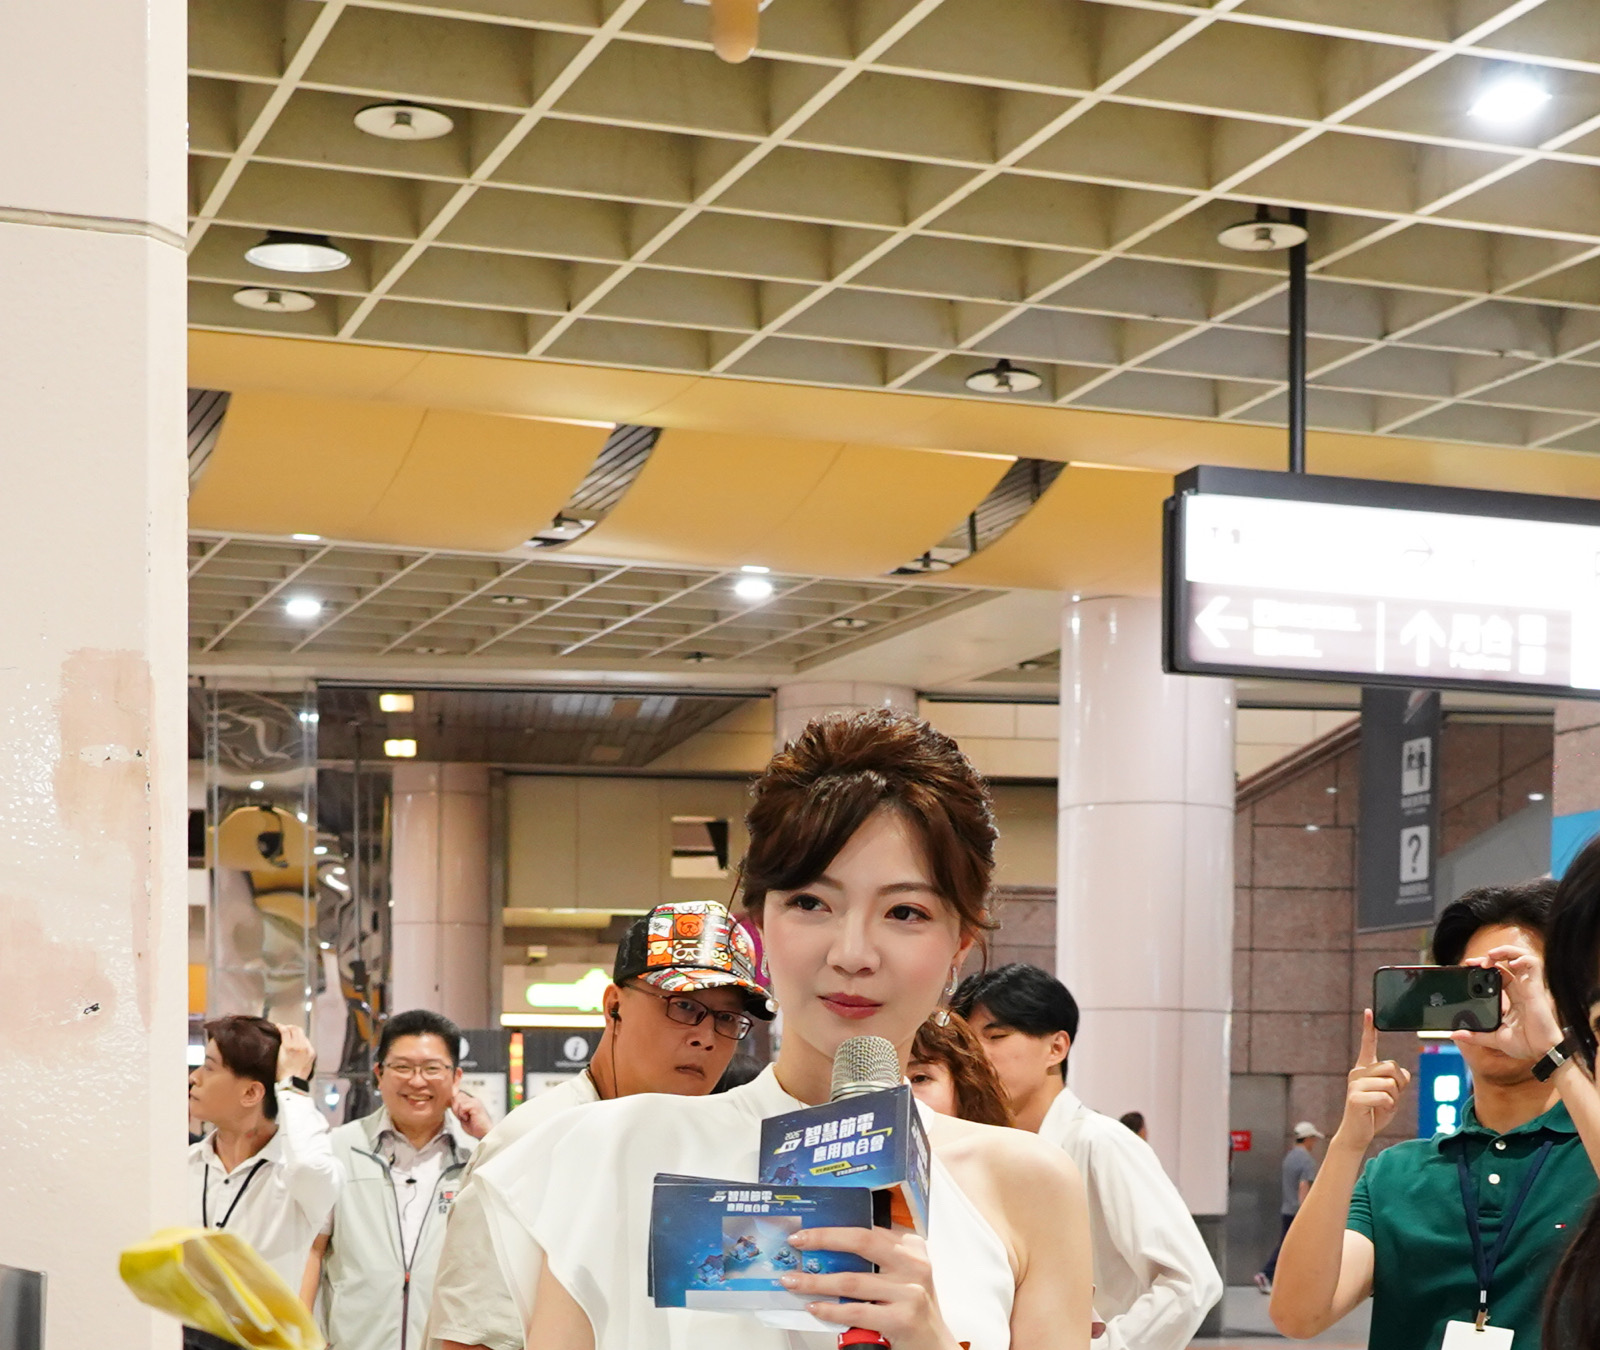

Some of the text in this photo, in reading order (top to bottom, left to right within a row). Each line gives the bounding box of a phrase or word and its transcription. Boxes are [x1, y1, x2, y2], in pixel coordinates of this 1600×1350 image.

[804, 1112, 875, 1148] 智慧節電
[812, 1134, 885, 1163] 應用媒合會
